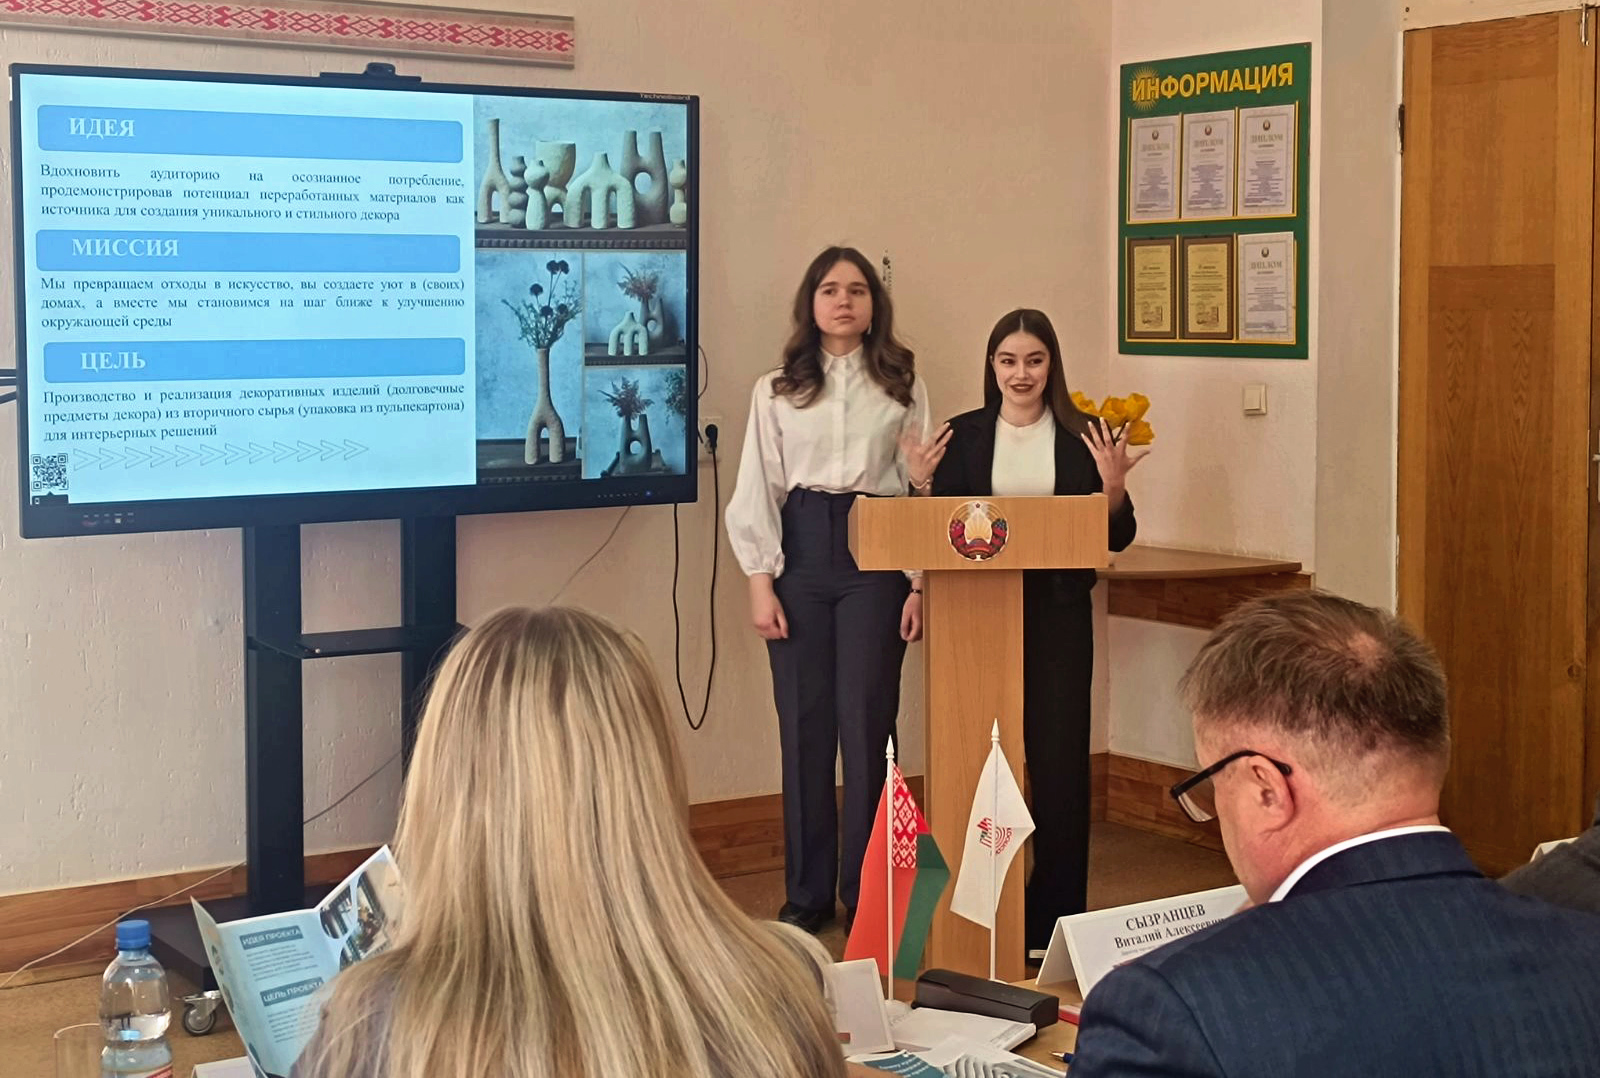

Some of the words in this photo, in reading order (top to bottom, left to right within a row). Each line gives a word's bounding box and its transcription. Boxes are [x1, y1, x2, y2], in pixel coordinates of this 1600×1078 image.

[1132, 62, 1294, 102] ИНФОРМАЦИЯ
[68, 117, 135, 139] ИДЕЯ
[40, 164, 120, 178] Вдохновить
[150, 169, 219, 182] аудиторию
[249, 172, 263, 182] на
[292, 172, 361, 183] осознанное
[389, 175, 464, 188] потребление,
[41, 186, 172, 200] продемонстрировав
[184, 189, 249, 200] потенциал
[260, 189, 359, 203] переработанных
[370, 194, 436, 205] материалов
[446, 194, 464, 204] как
[41, 205, 110, 216] источника
[114, 205, 136, 216] для
[140, 206, 198, 217] создания
[202, 208, 281, 220] уникального
[285, 209, 292, 218] и
[296, 209, 357, 219] стильного
[360, 211, 399, 223] декора
[72, 238, 179, 256] МИССИЯ
[41, 277, 65, 289] Мы
[73, 280, 153, 292] превращаем
[161, 279, 206, 290] отходы
[214, 281, 221, 289] в
[228, 280, 294, 293] искусство,
[300, 280, 317, 289] вы
[323, 280, 374, 290] создаете
[381, 281, 402, 292] уют
[410, 281, 416, 289] в
[423, 279, 464, 291] (своих)
[41, 299, 85, 310] домах,
[96, 299, 103, 308] а
[113, 299, 158, 308] вместе
[168, 299, 187, 308] мы
[197, 297, 270, 308] становимся
[280, 297, 294, 307] на
[303, 297, 327, 307] шаг
[336, 296, 372, 307] ближе
[382, 297, 389, 307] к
[397, 298, 465, 310] улучшению
[41, 315, 129, 330] окружающей
[133, 316, 172, 329] среды
[81, 352, 146, 372] ЦЕЛЬ
[43, 391, 136, 405] Производство
[145, 391, 152, 400] и
[160, 390, 232, 403] реализация
[239, 387, 325, 400] декоративных
[332, 385, 380, 396] изделий
[387, 384, 465, 396] (долговечные
[44, 411, 109, 424] предметы
[113, 408, 161, 422] декора)
[166, 409, 180, 419] из
[184, 407, 254, 420] вторичного
[258, 407, 294, 418] сырья
[298, 404, 356, 418] (упаковка
[360, 404, 372, 413] из
[376, 401, 465, 414] пульпекартона)
[44, 431, 67, 442] для
[71, 428, 156, 440] интерьерных
[161, 425, 217, 440] решений
[1126, 903, 1206, 931] СЫЗРАНЦЕВ
[1114, 927, 1162, 949] Виталий
